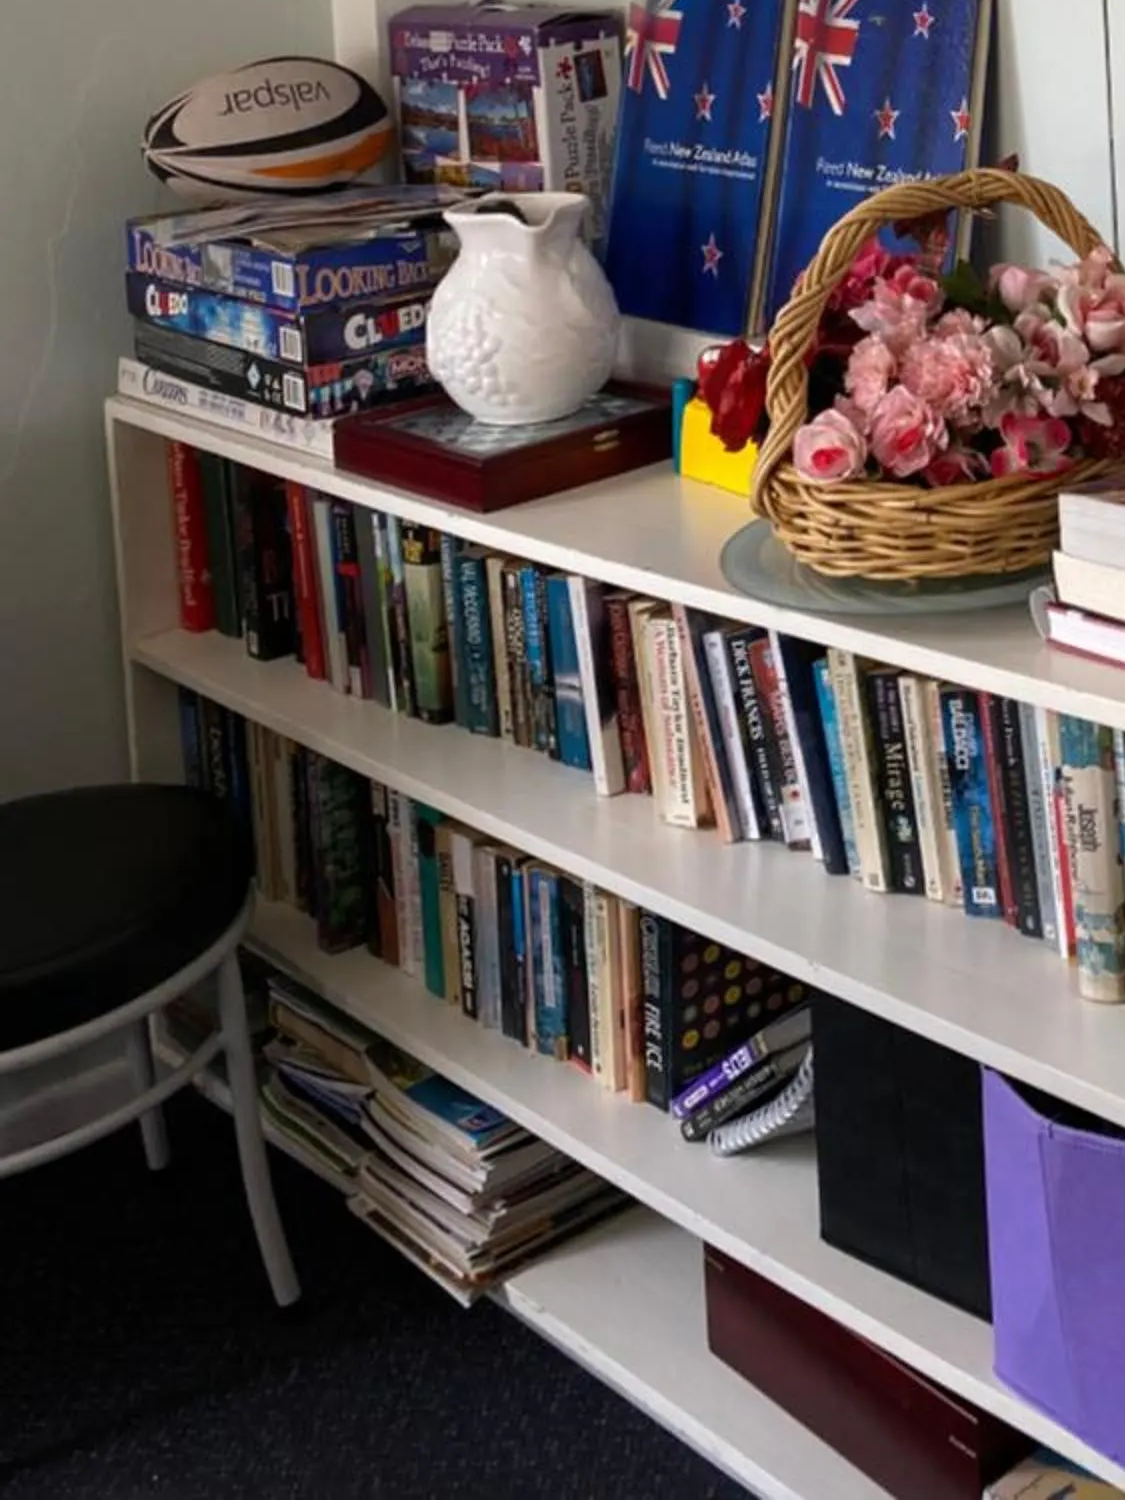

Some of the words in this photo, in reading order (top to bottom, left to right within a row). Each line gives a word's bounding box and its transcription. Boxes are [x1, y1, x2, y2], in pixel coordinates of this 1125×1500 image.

[220, 79, 331, 118] valspar
[557, 82, 577, 126] Pack
[563, 130, 579, 180] Puzzle
[847, 161, 874, 179] New
[296, 263, 395, 306] LOOKING
[731, 638, 751, 677] DICK
[739, 678, 765, 742] FRANCIS
[884, 741, 907, 811] Mirage
[645, 1002, 662, 1041] FIRE
[646, 1043, 663, 1073] ICE
